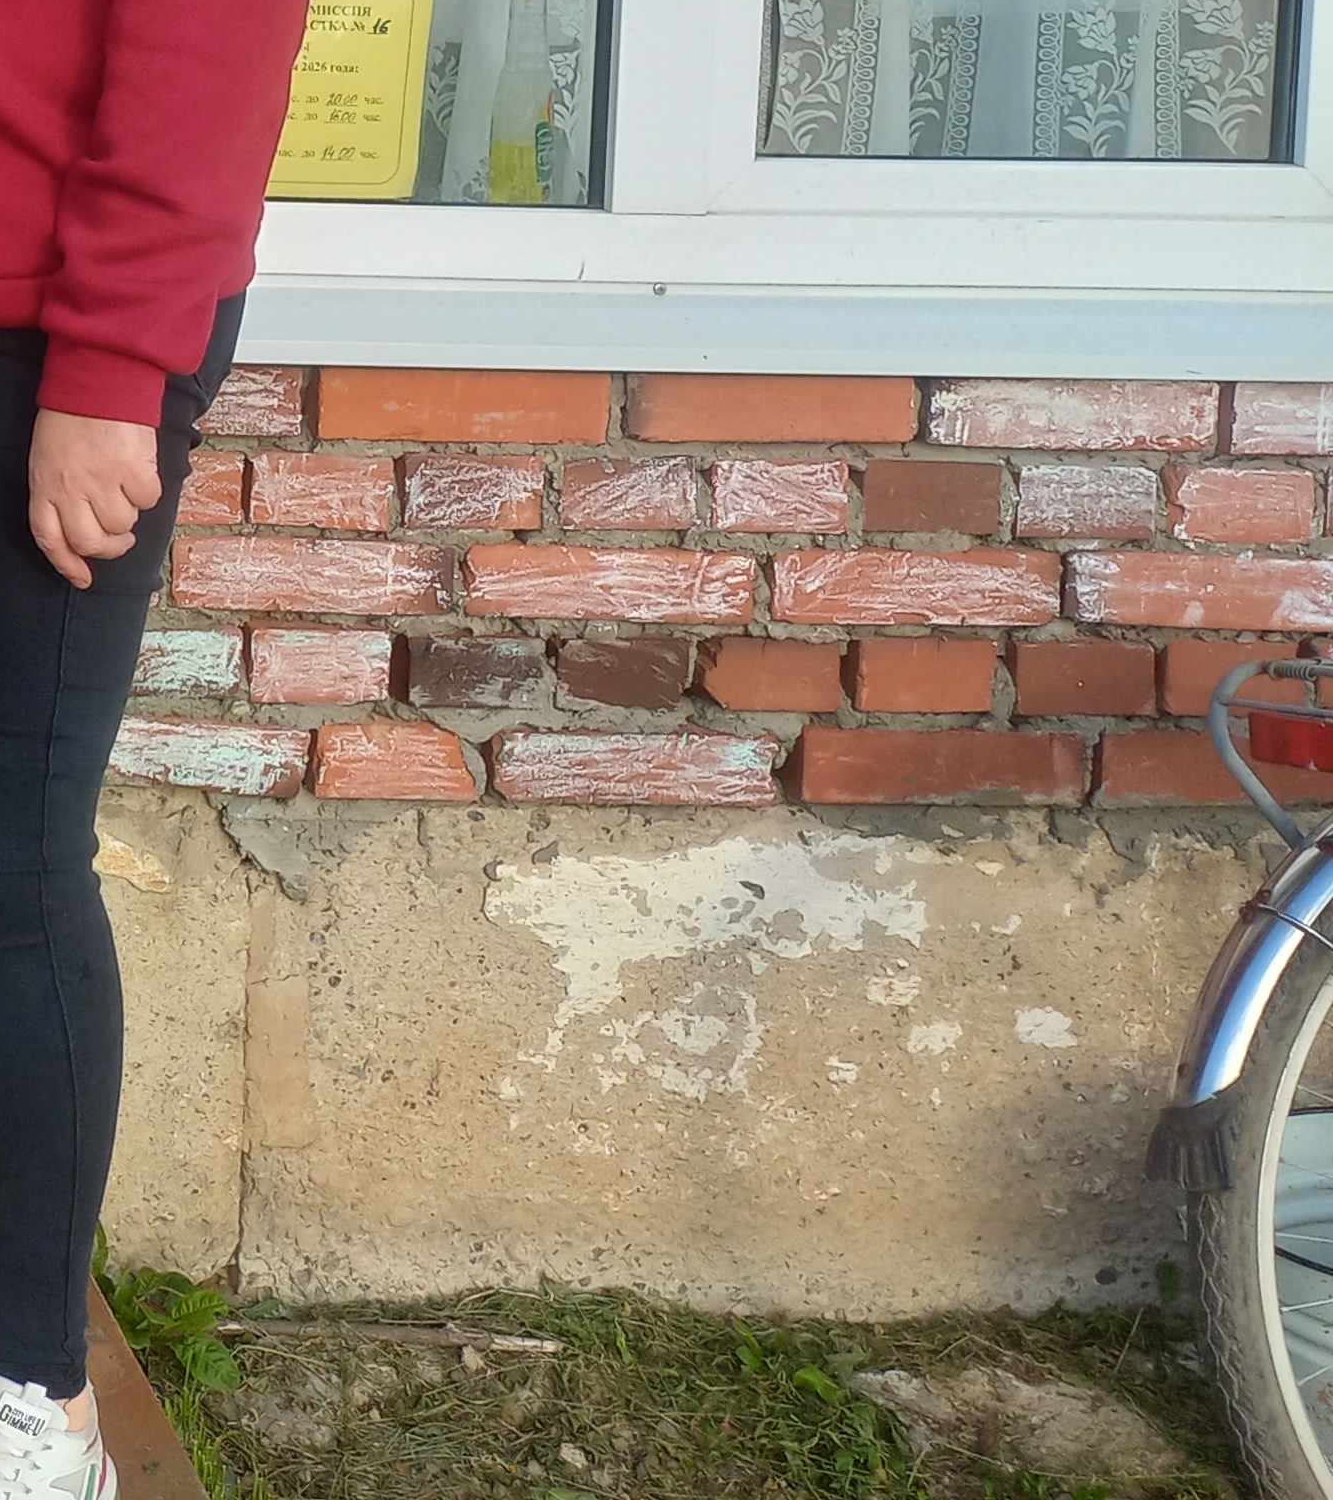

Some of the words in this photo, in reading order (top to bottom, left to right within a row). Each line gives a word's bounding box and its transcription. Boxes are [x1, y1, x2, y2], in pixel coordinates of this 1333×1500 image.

[309, 5, 372, 17] МИССИЯ
[371, 17, 392, 34] 16
[301, 62, 328, 72] 2026
[330, 63, 359, 74] года:
